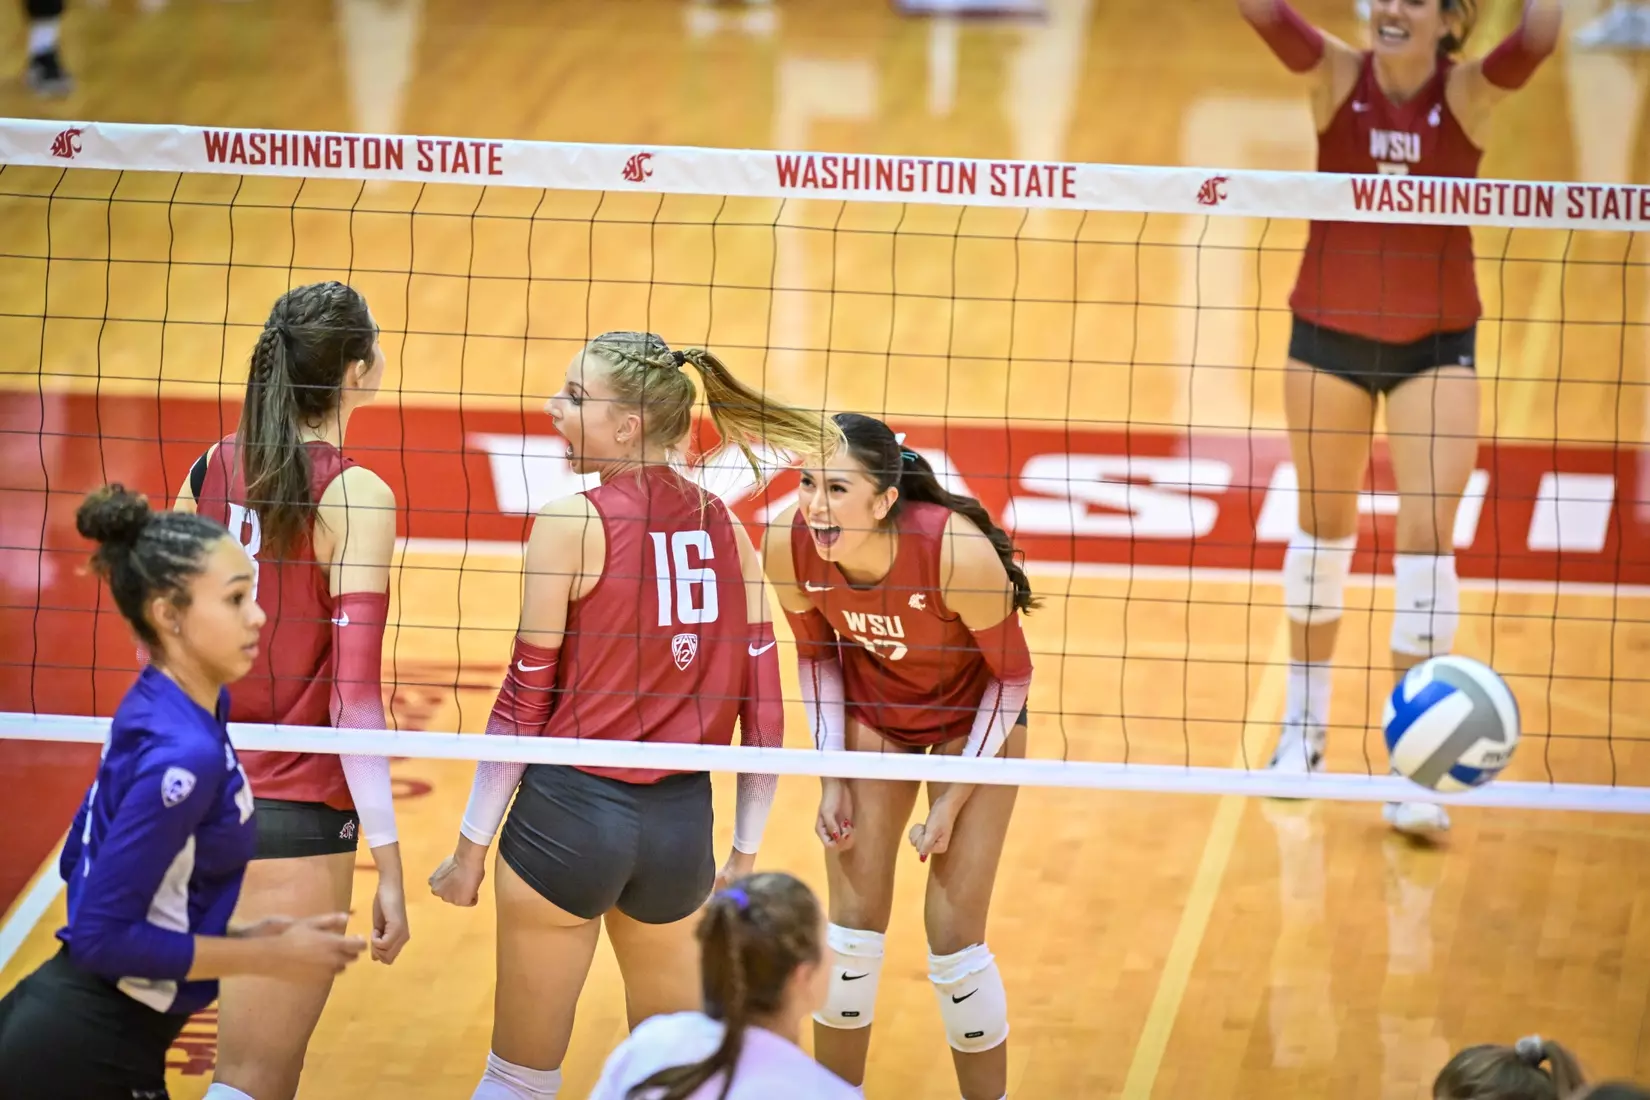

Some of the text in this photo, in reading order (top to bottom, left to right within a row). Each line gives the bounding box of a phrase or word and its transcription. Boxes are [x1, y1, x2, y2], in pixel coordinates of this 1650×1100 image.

[203, 130, 503, 176] WASHINGTON STATE
[1369, 128, 1420, 162] WSU
[776, 154, 1077, 199] WASHINGTON STATE
[1351, 177, 1650, 221] WASHINGTON STATE
[648, 529, 719, 627] 16
[841, 610, 905, 638] WSU
[677, 649, 691, 663] 12
